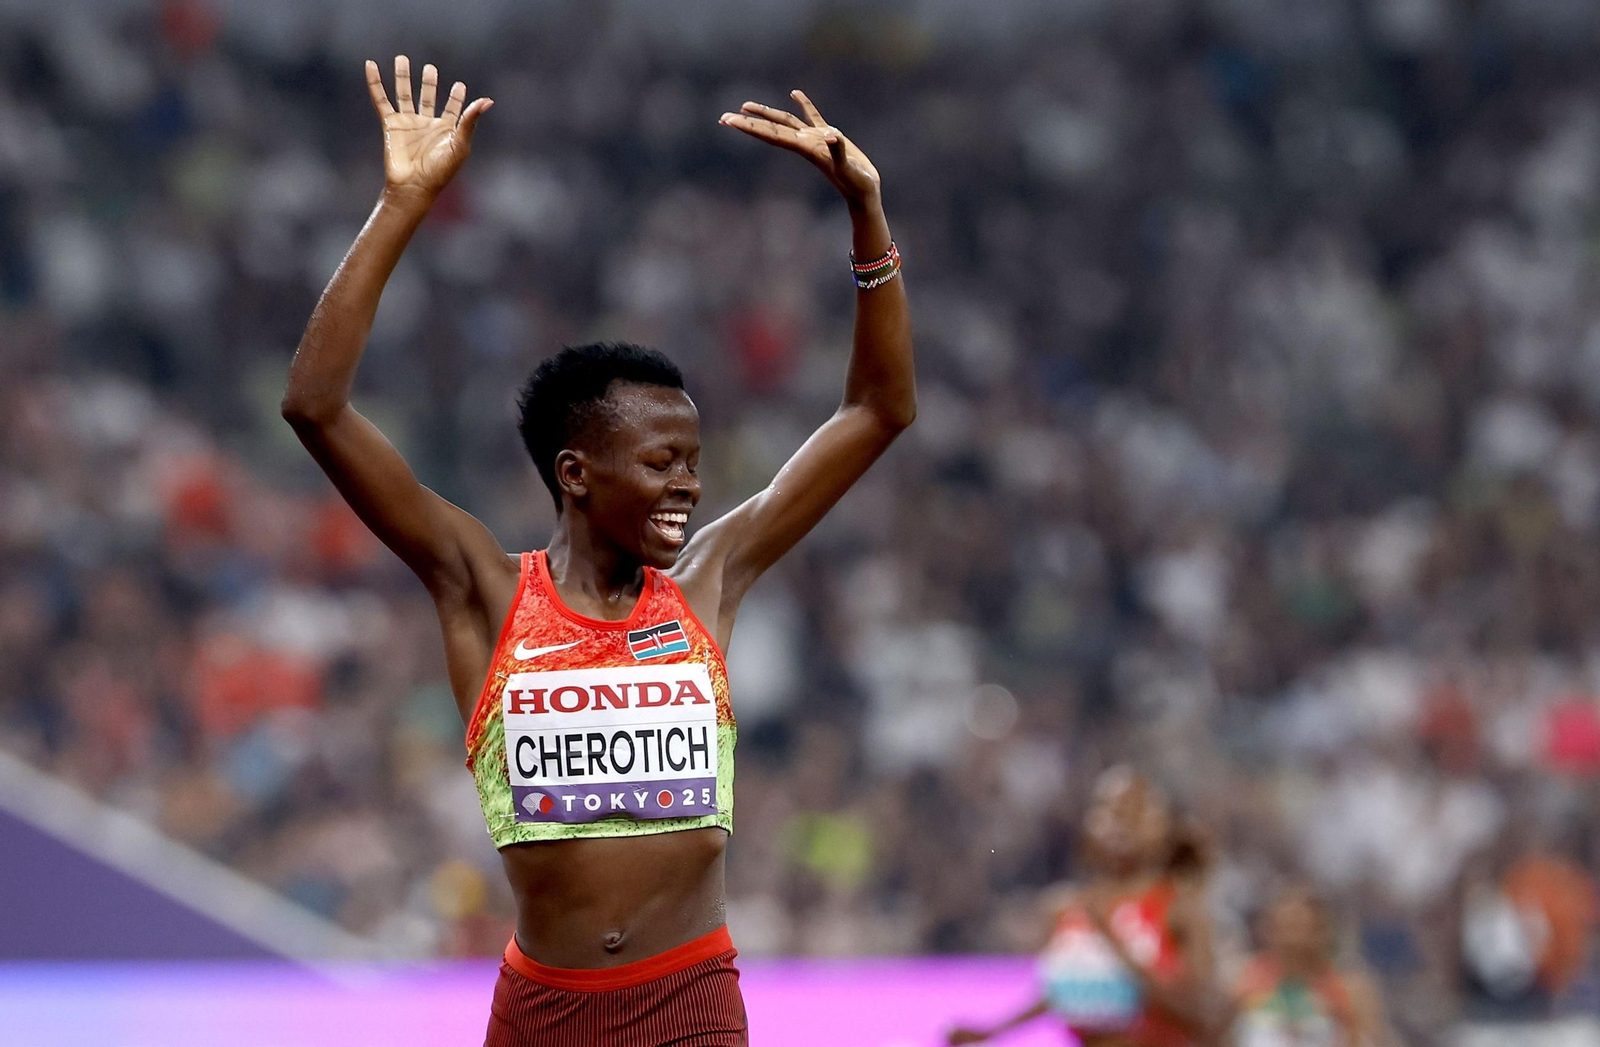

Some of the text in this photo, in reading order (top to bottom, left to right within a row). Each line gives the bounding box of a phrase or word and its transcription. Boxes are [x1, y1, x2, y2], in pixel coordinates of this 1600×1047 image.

[507, 680, 710, 714] HONDA
[515, 726, 709, 779] CHEROTICH
[562, 788, 711, 811] TOKYO 25
